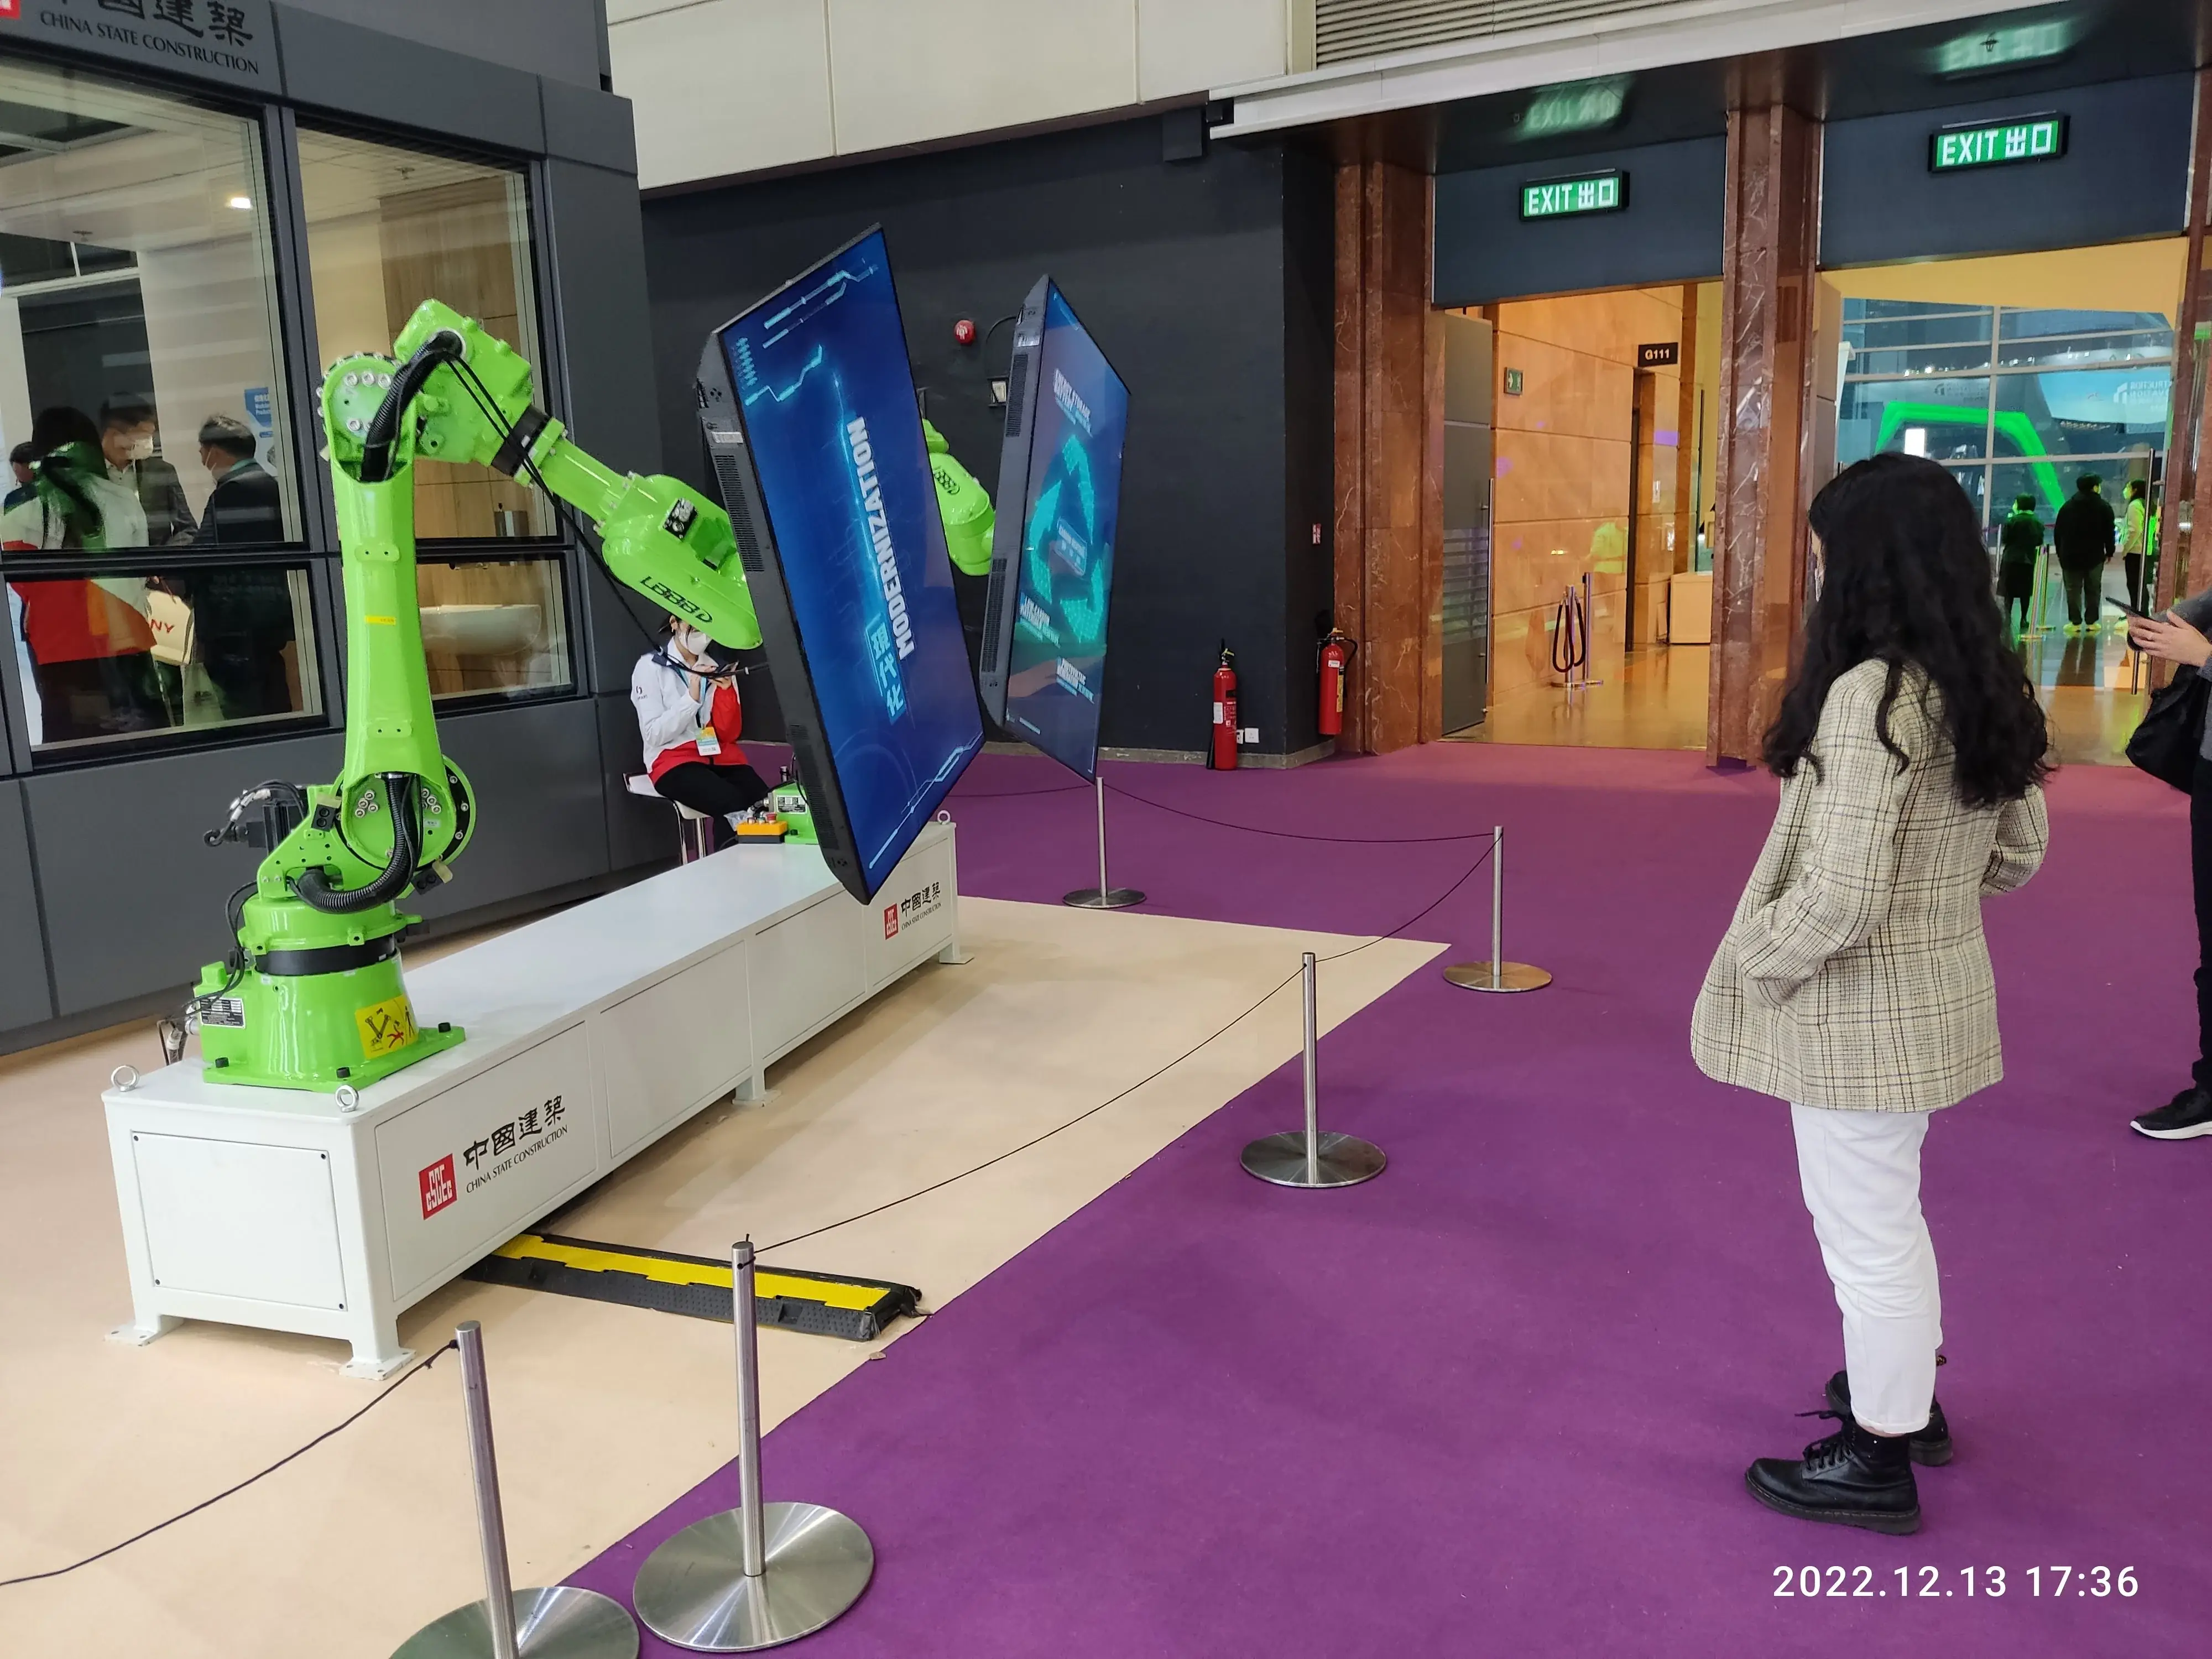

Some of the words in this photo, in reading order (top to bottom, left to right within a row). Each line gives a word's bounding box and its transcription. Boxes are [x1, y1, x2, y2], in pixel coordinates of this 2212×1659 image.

[40, 11, 93, 35] CHINA
[97, 23, 138, 45] STATE
[142, 34, 259, 75] CONSTRUCTION
[1942, 129, 1999, 166] EXIT
[2005, 123, 2052, 158] 出口
[1528, 184, 1573, 214] EXIT
[1578, 178, 1614, 209] 出口
[1645, 348, 1670, 361] G111
[847, 416, 915, 660] MODERNIZATION
[871, 622, 904, 717] 現代化
[901, 881, 941, 917] 中國建築
[463, 1095, 565, 1171] 中國建築
[466, 1172, 492, 1193] CHINA
[493, 1158, 513, 1178] STATE
[513, 1124, 568, 1165] CONSTRUCTION
